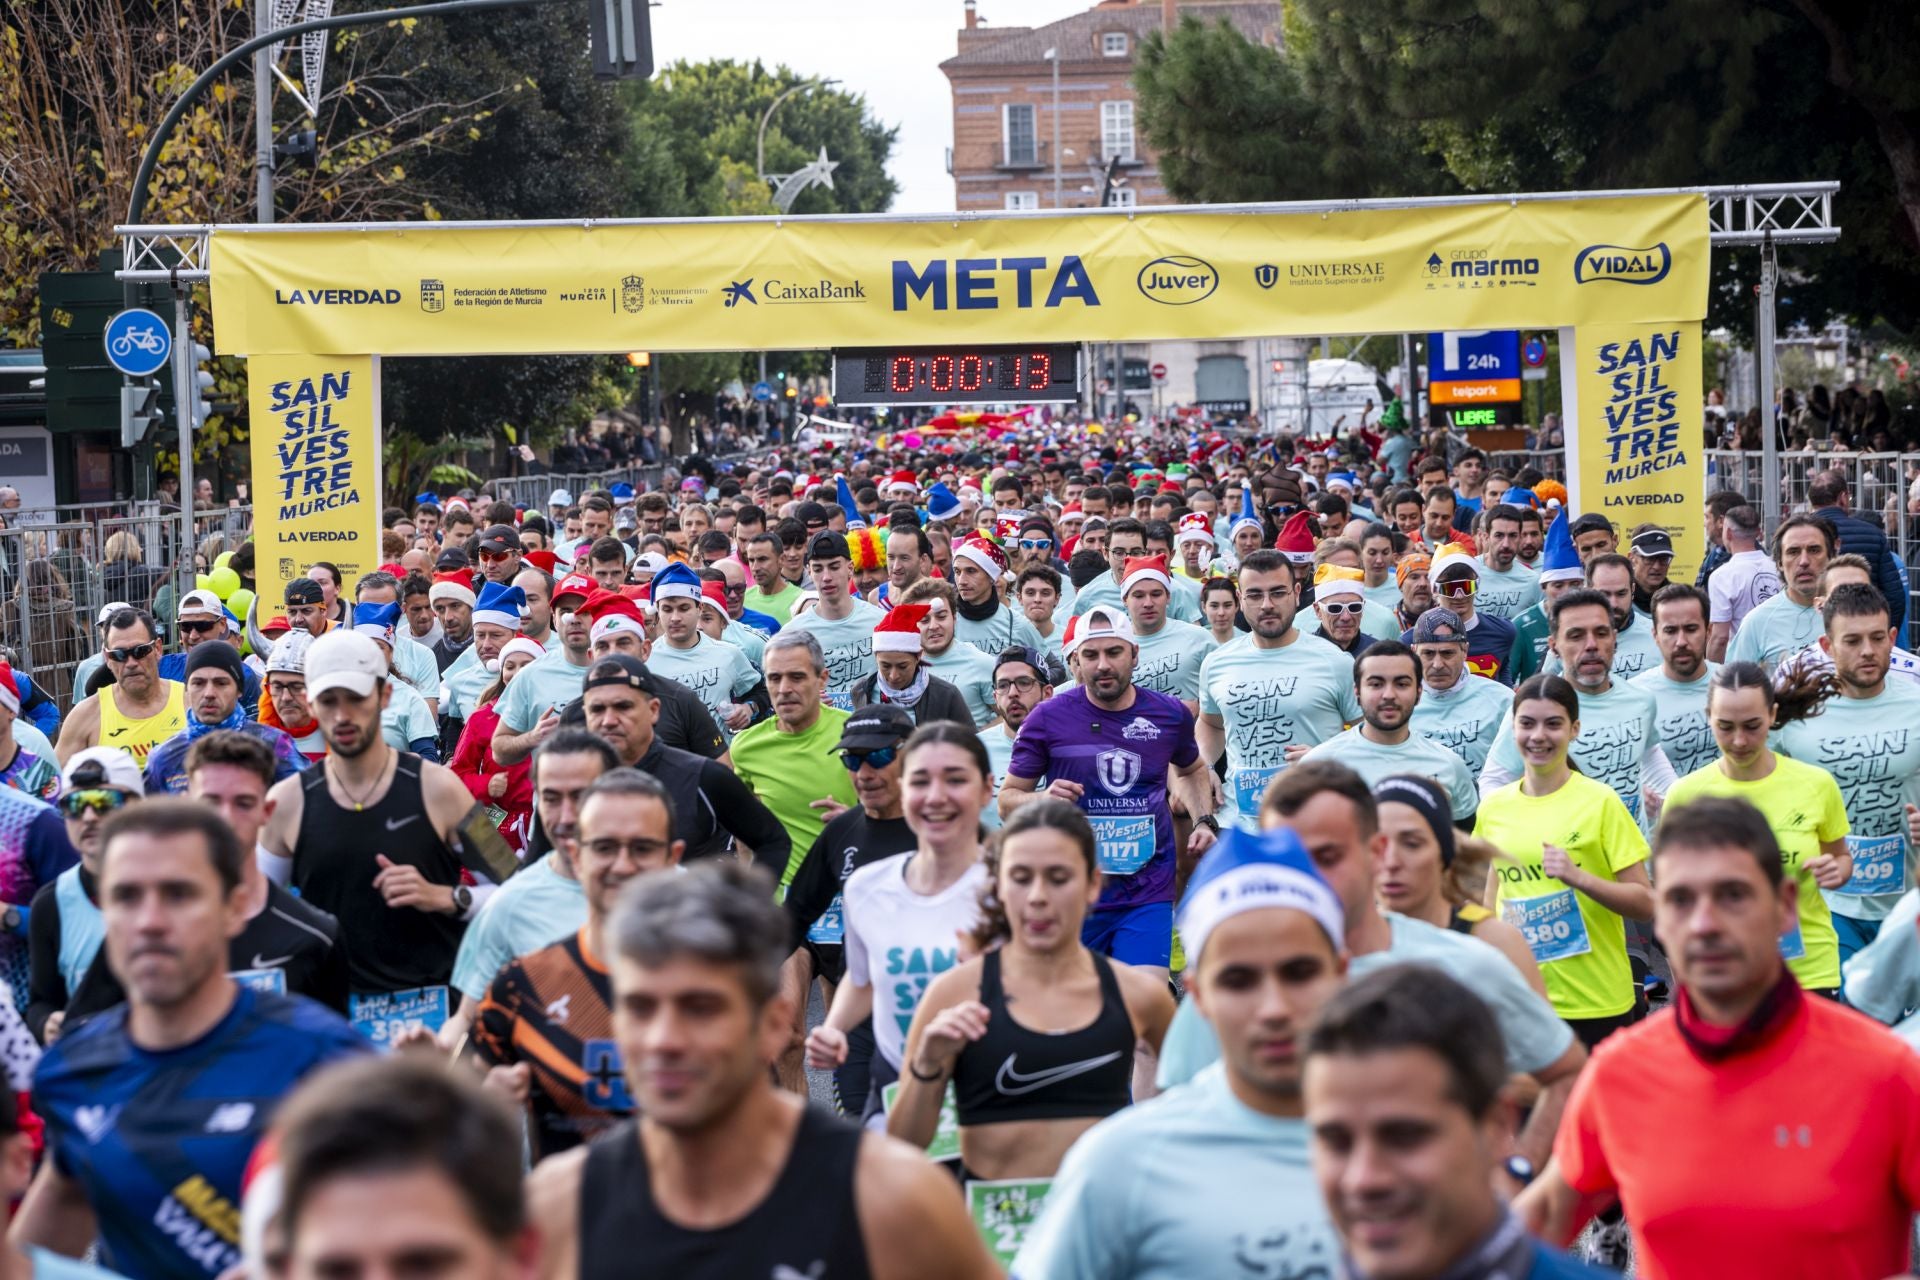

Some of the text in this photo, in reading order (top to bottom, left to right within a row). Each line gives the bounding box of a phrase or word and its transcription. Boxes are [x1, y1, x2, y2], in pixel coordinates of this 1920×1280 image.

[1450, 249, 1488, 261] Grupo
[1588, 255, 1658, 274] VIDAL
[1290, 262, 1385, 277] UNIVERSAE
[1451, 259, 1539, 277] marmo
[763, 279, 867, 299] CaixaBank
[891, 255, 1101, 311] META
[1146, 272, 1210, 290] Juver
[1289, 278, 1322, 286] Instituto
[1324, 277, 1359, 287] Superior
[1361, 276, 1371, 284] de
[275, 289, 402, 305] LA VERDAD
[454, 287, 547, 297] Federación de Atletismo
[454, 296, 543, 308] de la Región de Murcia
[559, 293, 607, 301] MURCIA
[649, 287, 709, 297] Ayuntamiento
[649, 296, 693, 305] de Murcia
[1467, 354, 1500, 370] 24h
[1596, 331, 1683, 374] SAN
[269, 371, 352, 412] SAN
[1609, 364, 1669, 403] SIL
[1455, 410, 1496, 425] LIBRE
[1602, 391, 1678, 433] VES
[282, 404, 340, 441] SIL
[0, 443, 22, 455] DA
[274, 430, 350, 470] VES
[1603, 422, 1681, 464] TRE
[1604, 451, 1687, 484] MURCIA
[276, 461, 353, 501] TRE
[278, 489, 361, 521] MURCIA
[1604, 493, 1684, 506] LA VERDAD
[278, 531, 359, 542] LA VERDAD
[1226, 676, 1299, 705] SAN
[1236, 698, 1286, 728] SIL
[1235, 720, 1295, 750] VES
[1574, 717, 1642, 755] SAN
[1817, 728, 1909, 764] SAN
[1240, 771, 1260, 781] SAN
[1832, 757, 1896, 789] SIL
[1095, 819, 1150, 842] ILVESTRE
[1101, 841, 1140, 858] 1171
[1851, 840, 1900, 860] VESTRE
[1521, 893, 1571, 926] VESTRE
